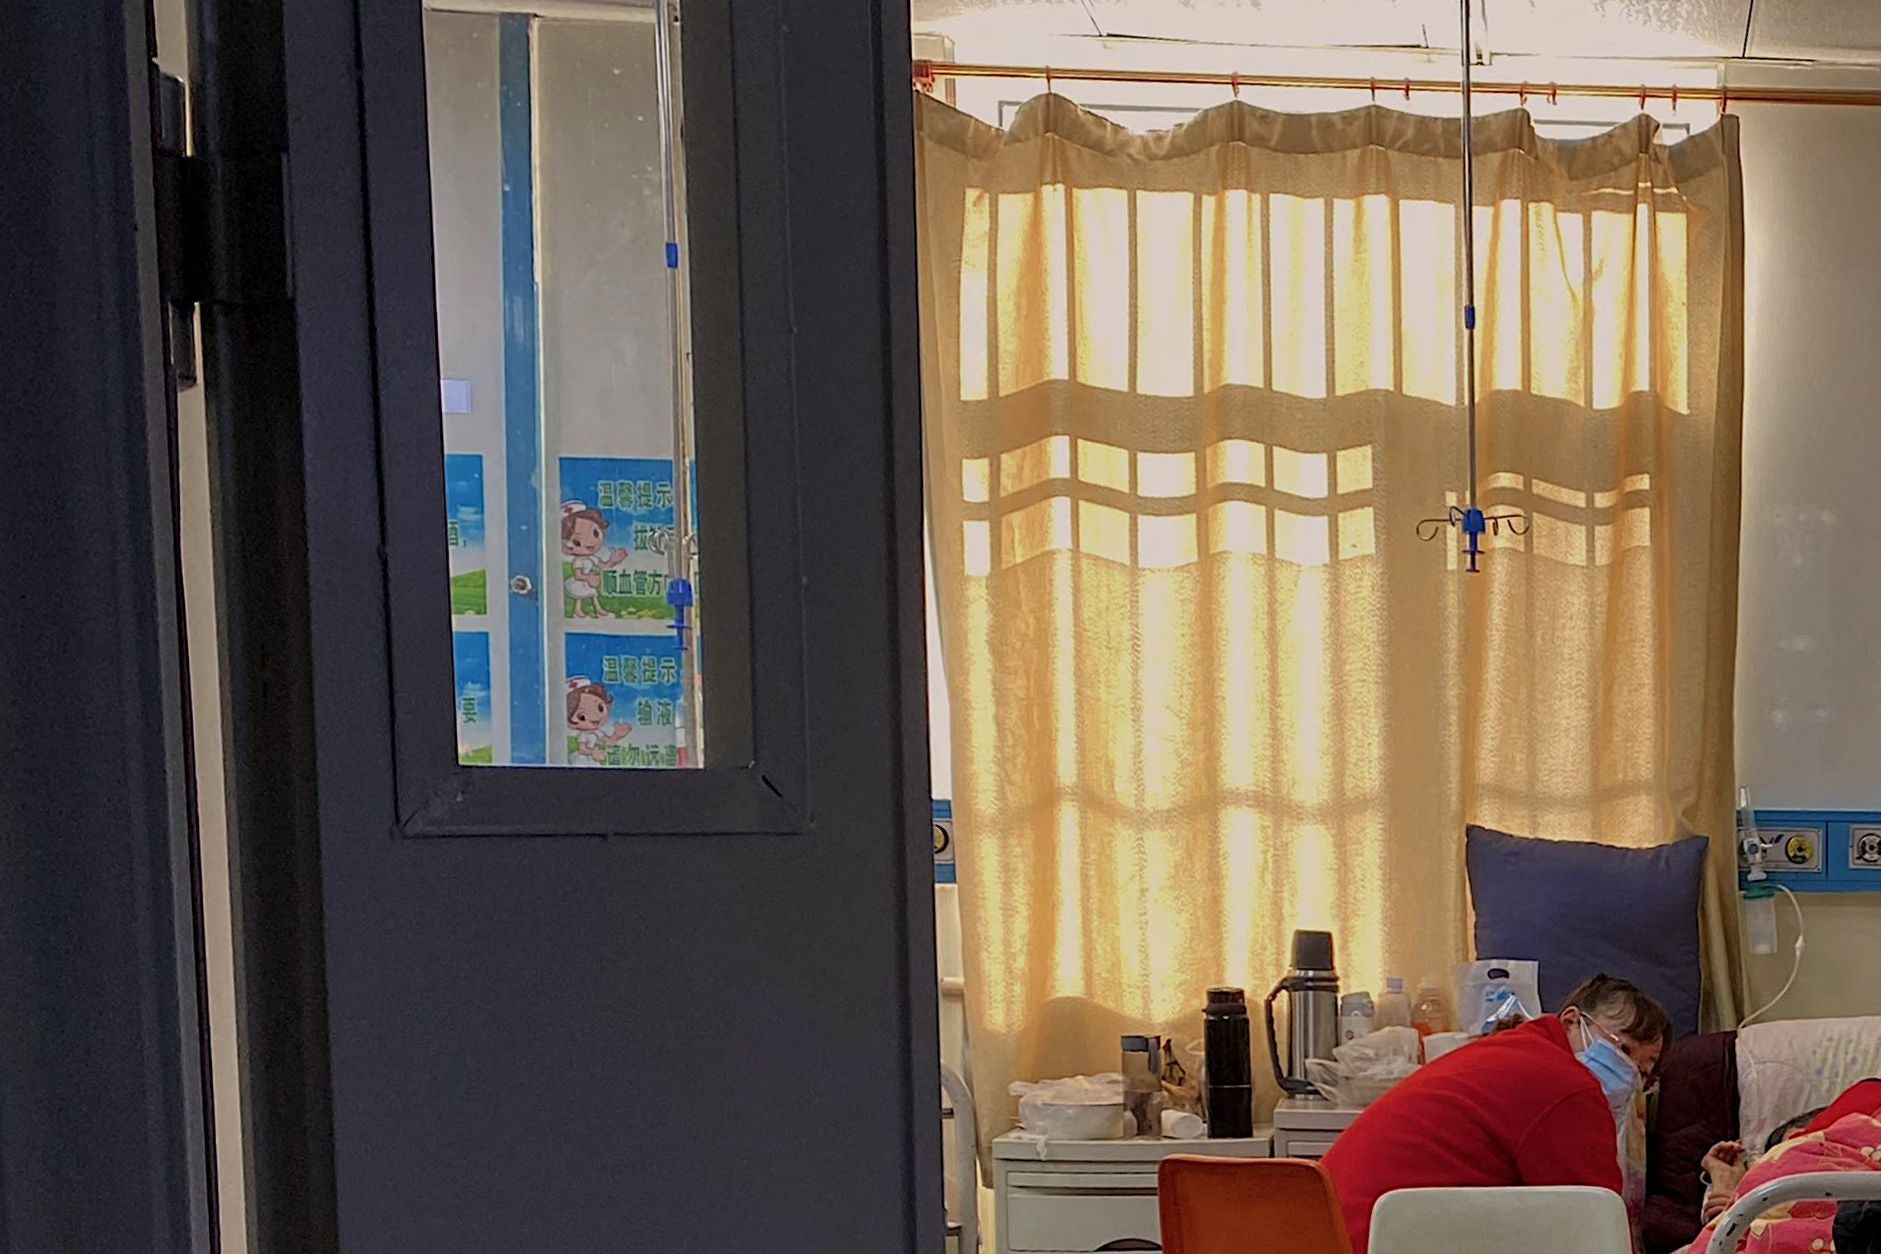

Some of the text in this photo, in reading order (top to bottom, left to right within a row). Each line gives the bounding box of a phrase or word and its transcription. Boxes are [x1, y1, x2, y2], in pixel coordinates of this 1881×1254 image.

[598, 480, 675, 511] 温馨提示
[602, 569, 670, 596] 顺血管方
[602, 656, 677, 685] 温馨提示
